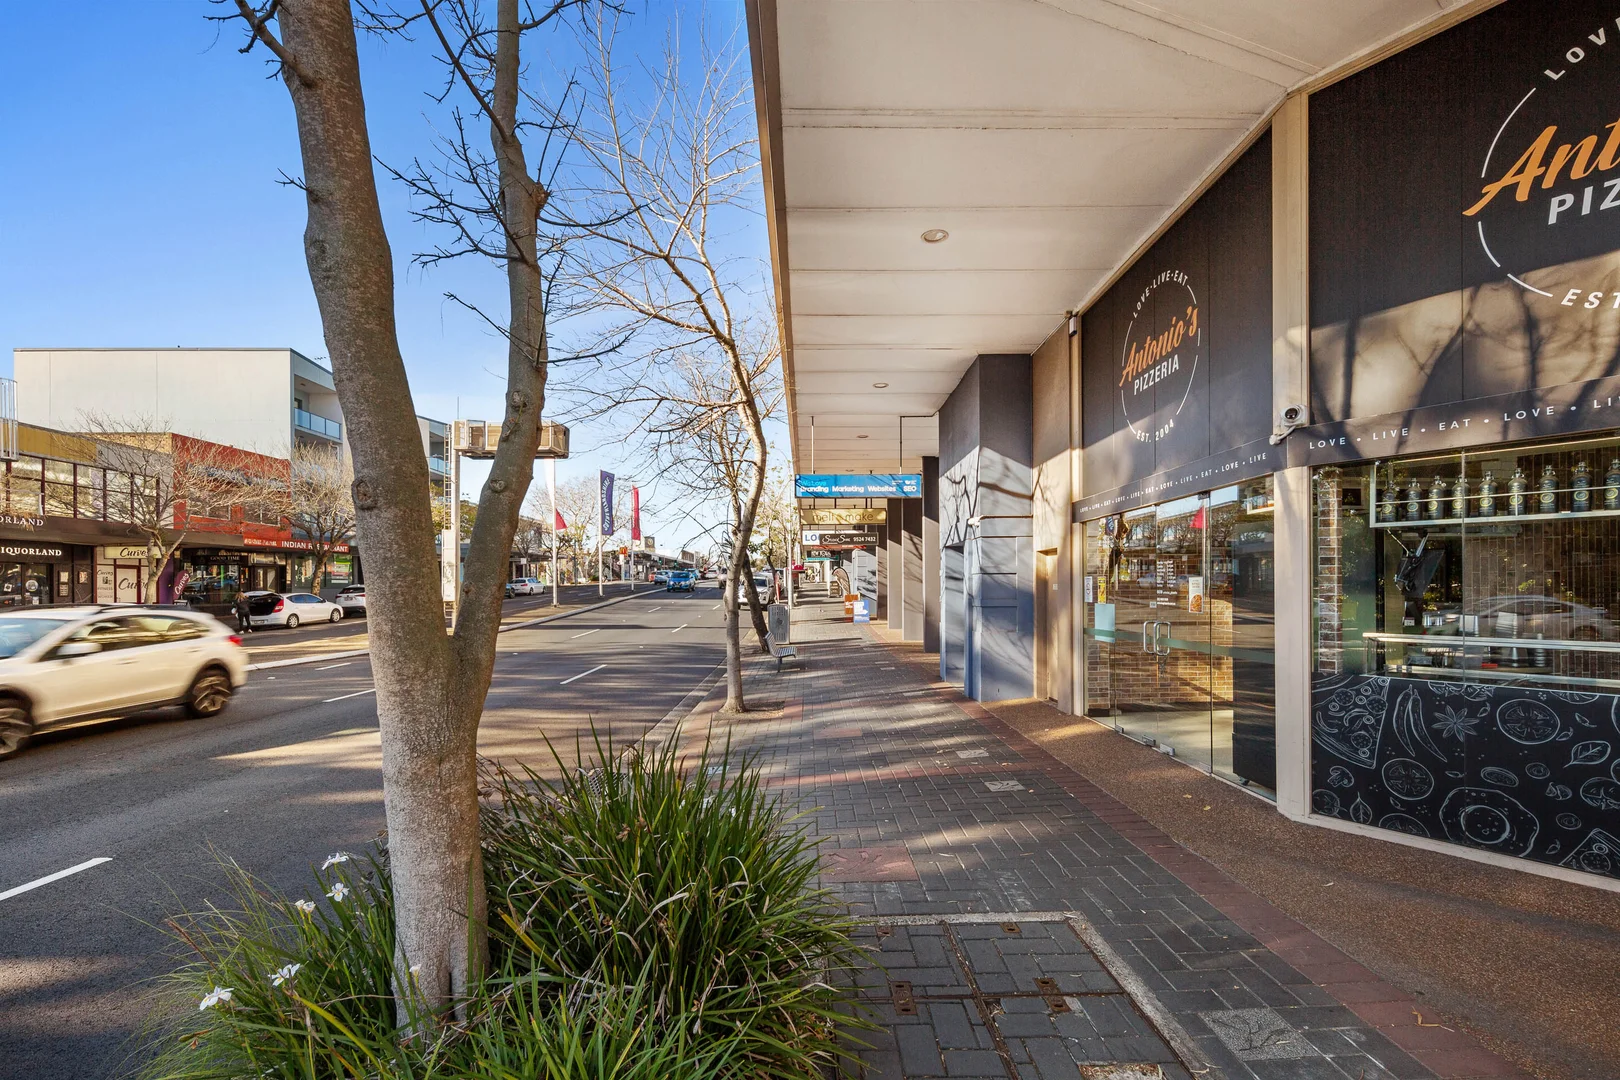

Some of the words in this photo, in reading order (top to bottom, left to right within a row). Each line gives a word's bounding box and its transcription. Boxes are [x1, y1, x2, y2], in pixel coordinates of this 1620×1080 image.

[1544, 16, 1620, 81] LOV
[1133, 286, 1151, 319] LOVE
[1153, 270, 1171, 290] LIVE
[1173, 269, 1188, 286] EAT
[1119, 305, 1199, 388] Antonio's
[1133, 353, 1180, 396] PIZZERIA
[1155, 418, 1175, 442] 2004
[1309, 436, 1346, 450] LOVE
[1372, 427, 1409, 441] LIVE
[1438, 418, 1471, 431] EAT
[1503, 405, 1555, 422] LOVE
[1593, 396, 1620, 409] LI
[832, 485, 865, 493] Marketing
[1115, 496, 1126, 504] LOVE
[1130, 491, 1141, 499] LIVE
[1145, 486, 1156, 495] EAT
[1160, 481, 1173, 490] LOVE
[1180, 475, 1193, 484] LIVE
[1201, 469, 1212, 478] EAT
[1221, 461, 1239, 472] LOVE
[1249, 452, 1267, 464] LIVE
[845, 512, 874, 521] make
[281, 541, 306, 549] INDIAN
[804, 533, 819, 542] LO
[174, 572, 189, 595] Curves
